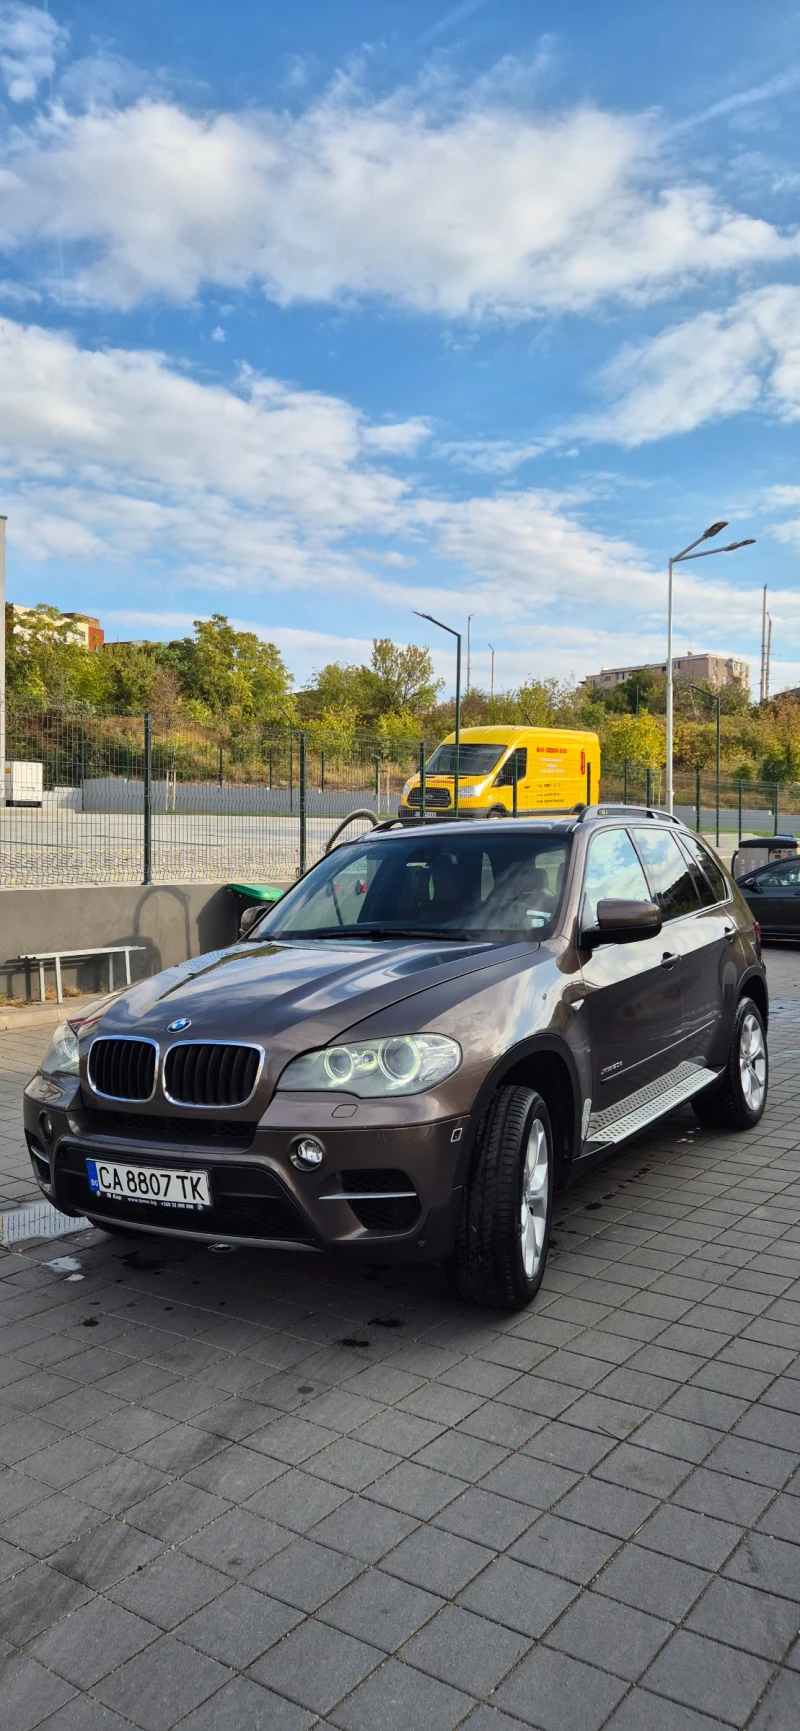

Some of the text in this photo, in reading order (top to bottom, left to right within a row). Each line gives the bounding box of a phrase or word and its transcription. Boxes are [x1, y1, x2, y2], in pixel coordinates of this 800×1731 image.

[91, 1179, 98, 1187] BG
[99, 1166, 205, 1201] CA 8807 TK
